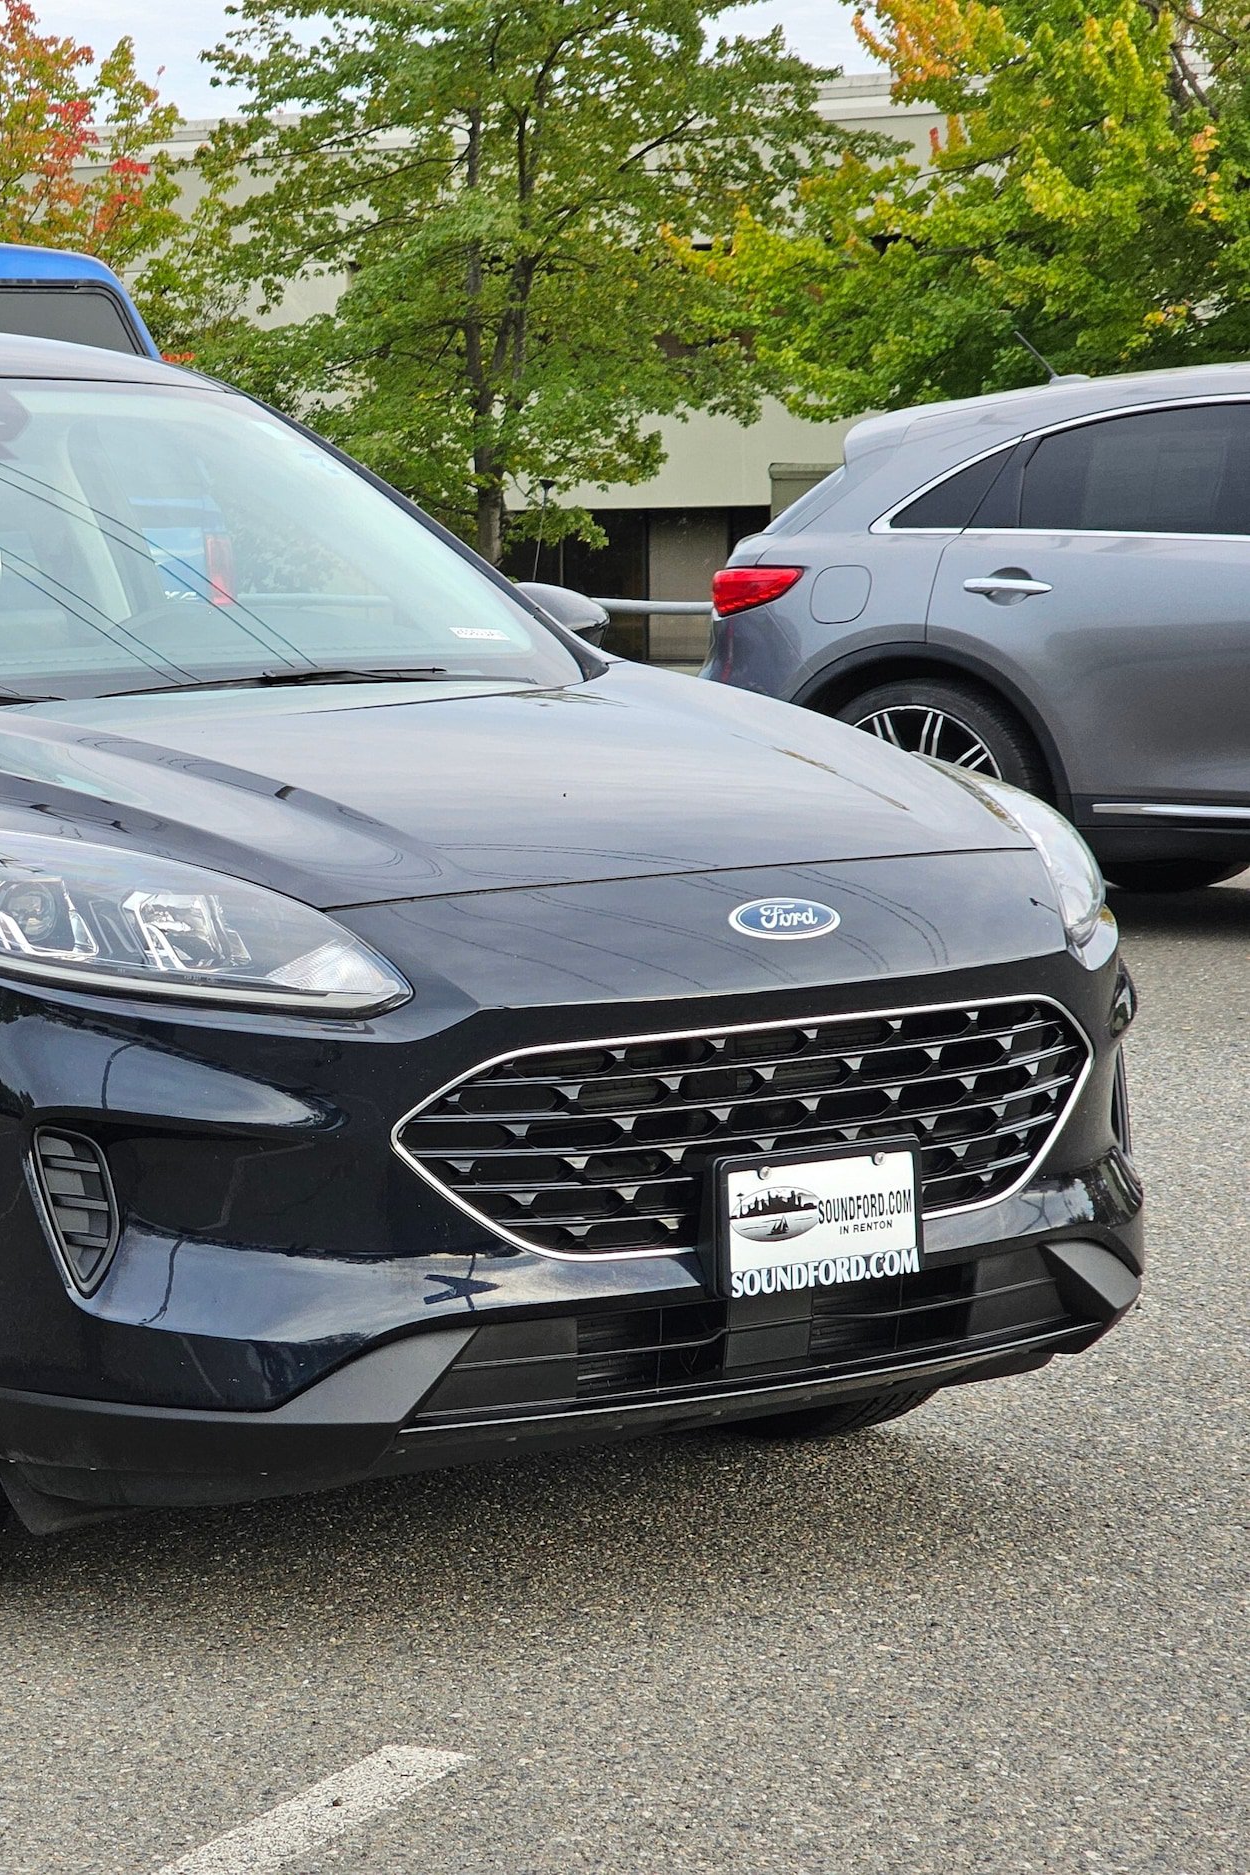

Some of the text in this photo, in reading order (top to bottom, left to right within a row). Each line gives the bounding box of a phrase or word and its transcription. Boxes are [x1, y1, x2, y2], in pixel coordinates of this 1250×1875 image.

[759, 904, 819, 929] Ford
[818, 1188, 913, 1224] SOUNDFORD.COM
[839, 1219, 893, 1235] IN RENTON
[731, 1247, 920, 1298] SOUNDFORD.COM
